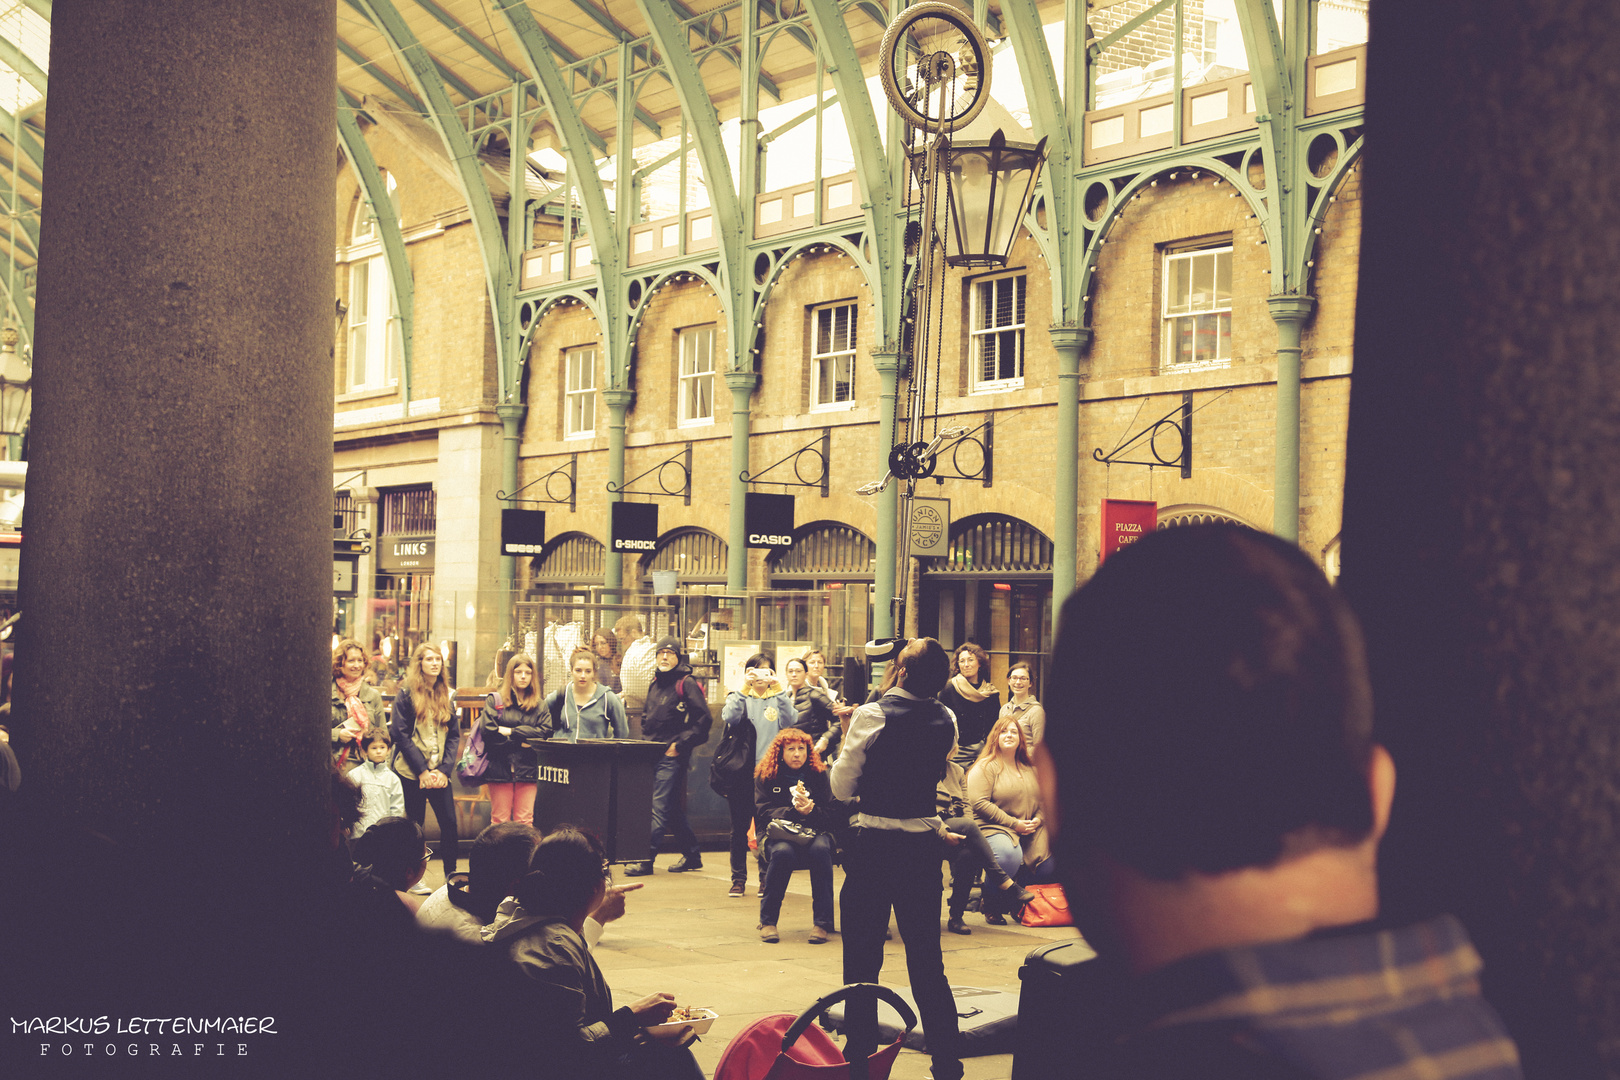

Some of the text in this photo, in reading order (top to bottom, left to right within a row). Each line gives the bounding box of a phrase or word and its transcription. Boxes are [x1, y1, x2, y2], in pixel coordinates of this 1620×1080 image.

[912, 508, 940, 523] UNION
[1115, 522, 1143, 532] PIAZZA
[615, 539, 656, 550] G-SHOCK
[749, 534, 792, 546] CASIO
[393, 543, 427, 556] LINKS
[537, 765, 570, 785] LITTER
